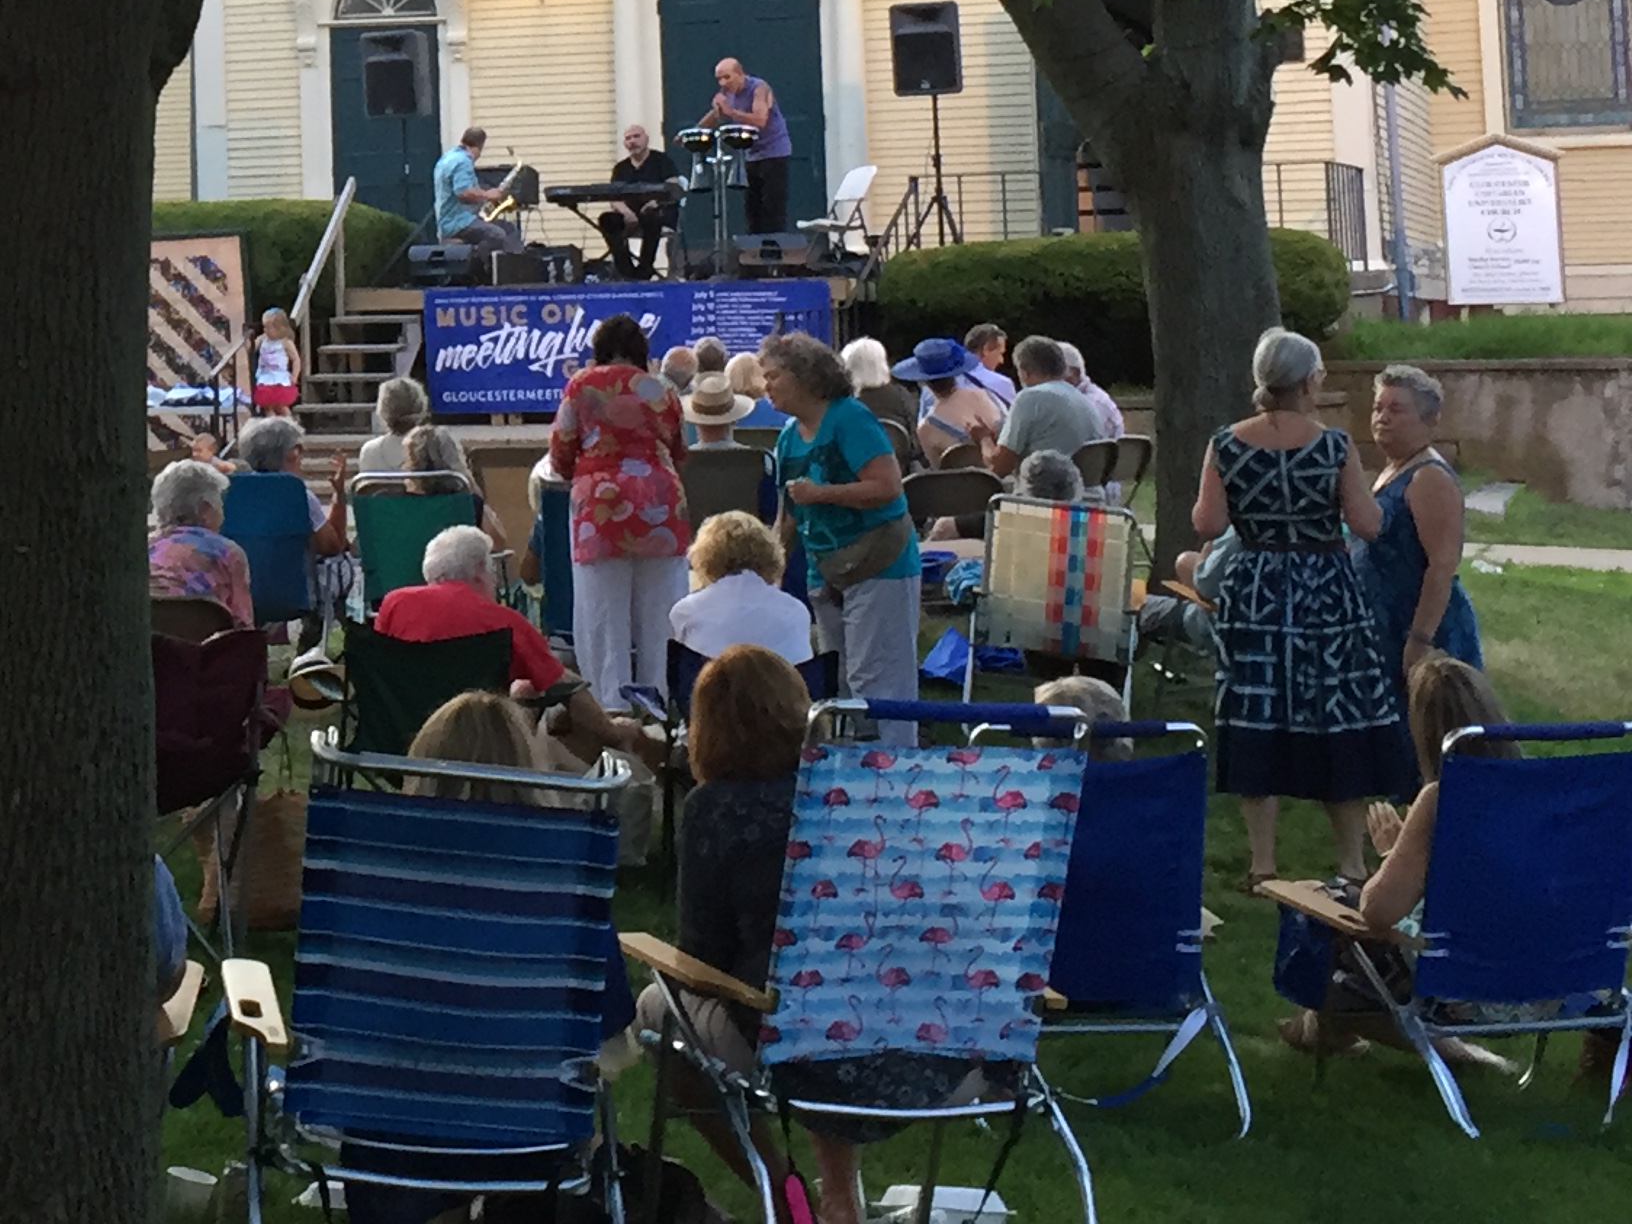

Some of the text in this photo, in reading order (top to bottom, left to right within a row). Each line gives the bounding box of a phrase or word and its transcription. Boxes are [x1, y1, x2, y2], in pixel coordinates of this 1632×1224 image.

[436, 303, 583, 327] MUSIC ON
[435, 306, 661, 377] meetinghe
